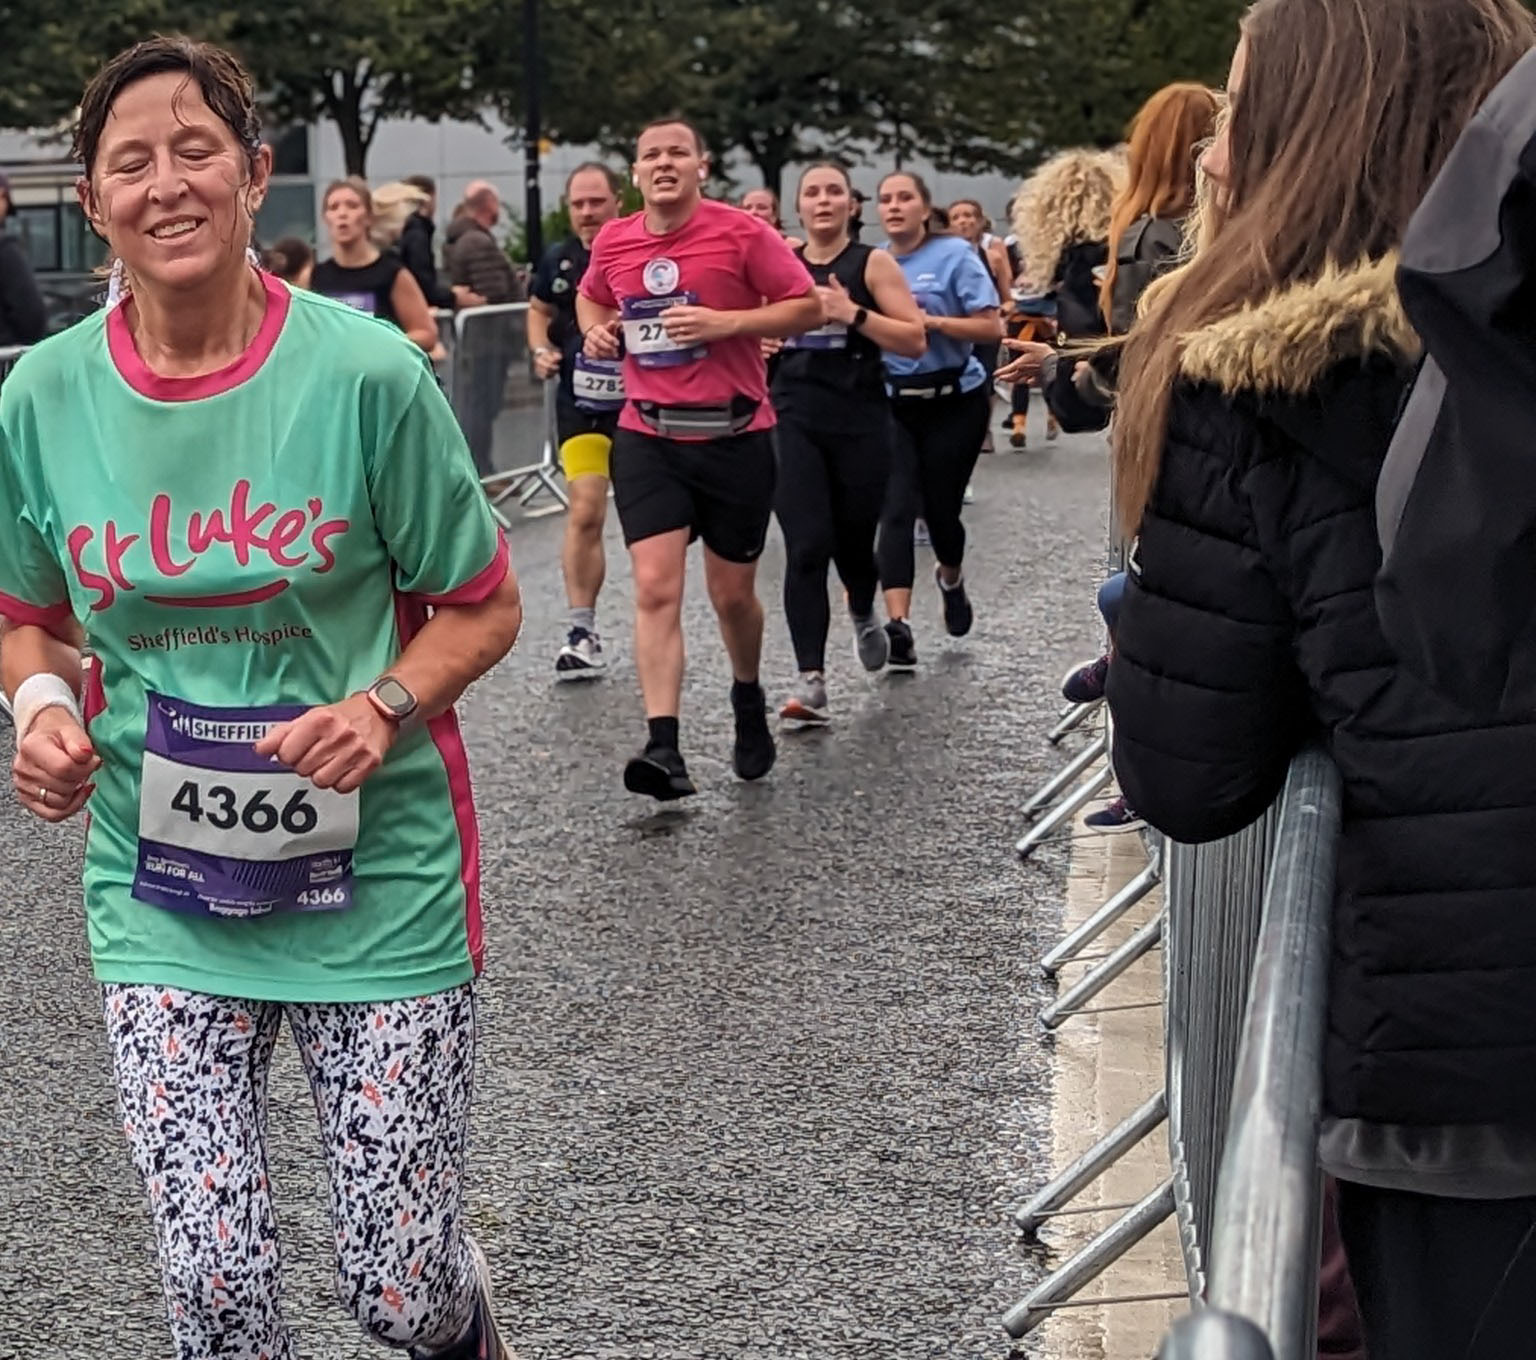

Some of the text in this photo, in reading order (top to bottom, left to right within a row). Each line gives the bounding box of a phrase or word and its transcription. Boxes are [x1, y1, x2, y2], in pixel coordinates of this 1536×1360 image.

[639, 323, 663, 342] 27
[67, 478, 350, 611] St Luke's
[128, 623, 312, 652] Sheffield's Hospice
[194, 722, 275, 740] SHEFFIEL
[171, 780, 318, 834] 4366
[297, 887, 345, 907] 4366
